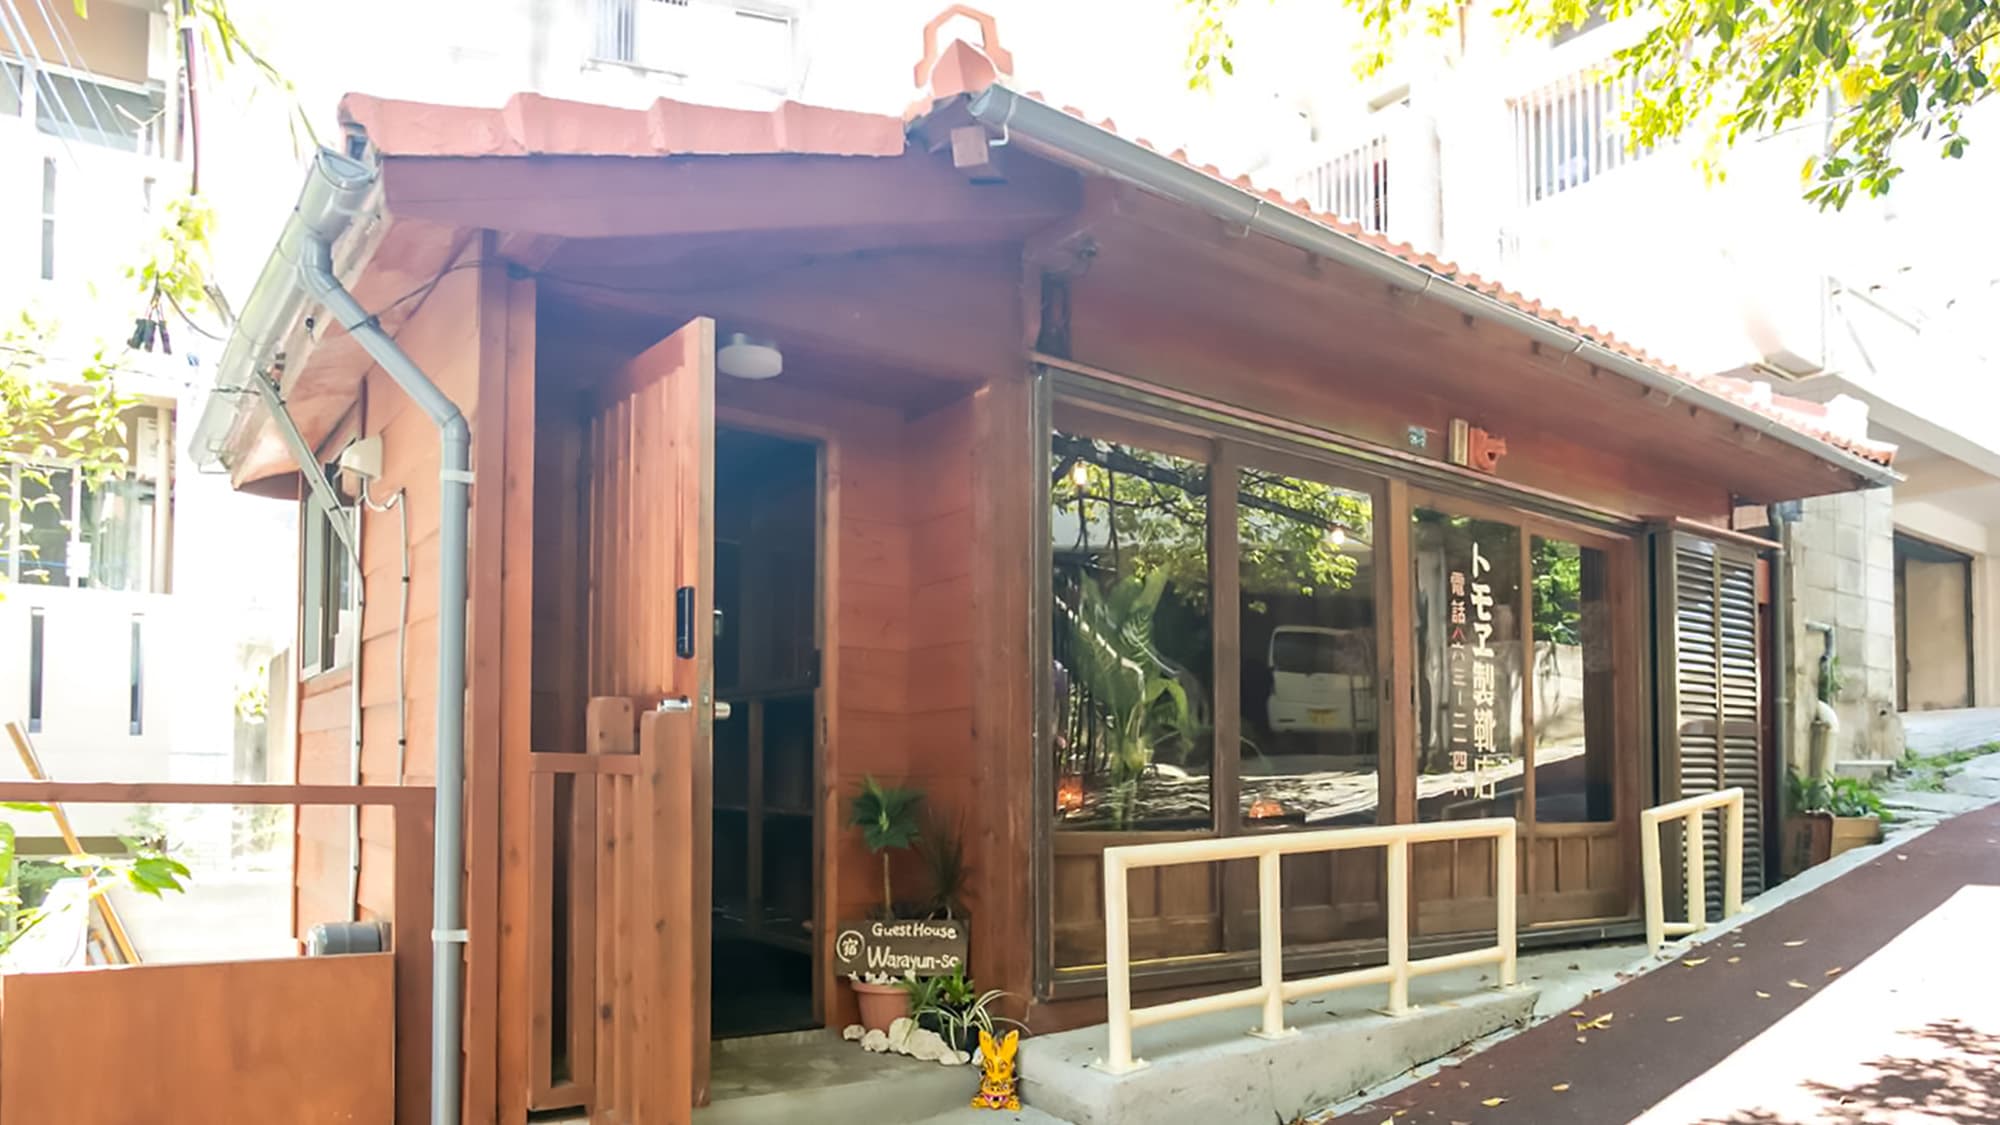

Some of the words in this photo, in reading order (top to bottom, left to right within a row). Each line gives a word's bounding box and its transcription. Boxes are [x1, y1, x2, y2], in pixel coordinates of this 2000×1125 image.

[872, 922, 912, 937] Guest
[913, 922, 957, 940] House
[841, 937, 859, 957] 宿
